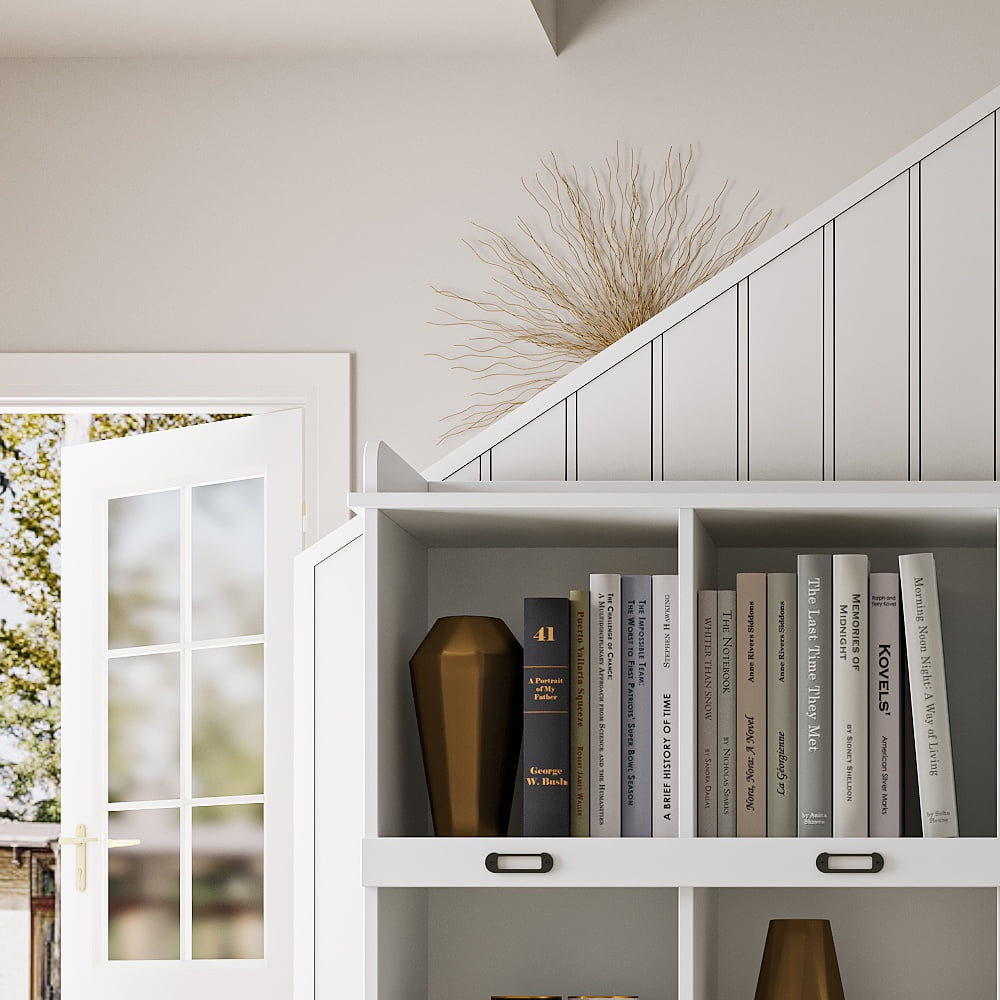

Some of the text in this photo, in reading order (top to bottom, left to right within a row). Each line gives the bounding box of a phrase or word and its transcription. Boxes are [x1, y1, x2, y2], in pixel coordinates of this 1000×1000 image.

[914, 577, 925, 622] Morning
[533, 627, 555, 641] 41
[852, 594, 860, 671] MEMORIES OF
[918, 626, 927, 651] Noon
[722, 610, 732, 694] THE NOTEBOOK
[807, 577, 820, 752] The Last Time They Met
[879, 645, 891, 715] KOVELS'
[921, 656, 932, 689] Night:
[925, 705, 936, 723] Way
[664, 723, 671, 735] OF
[928, 728, 937, 739] of
[530, 767, 562, 775] George
[929, 742, 938, 777] Living
[542, 777, 568, 785] Bush
